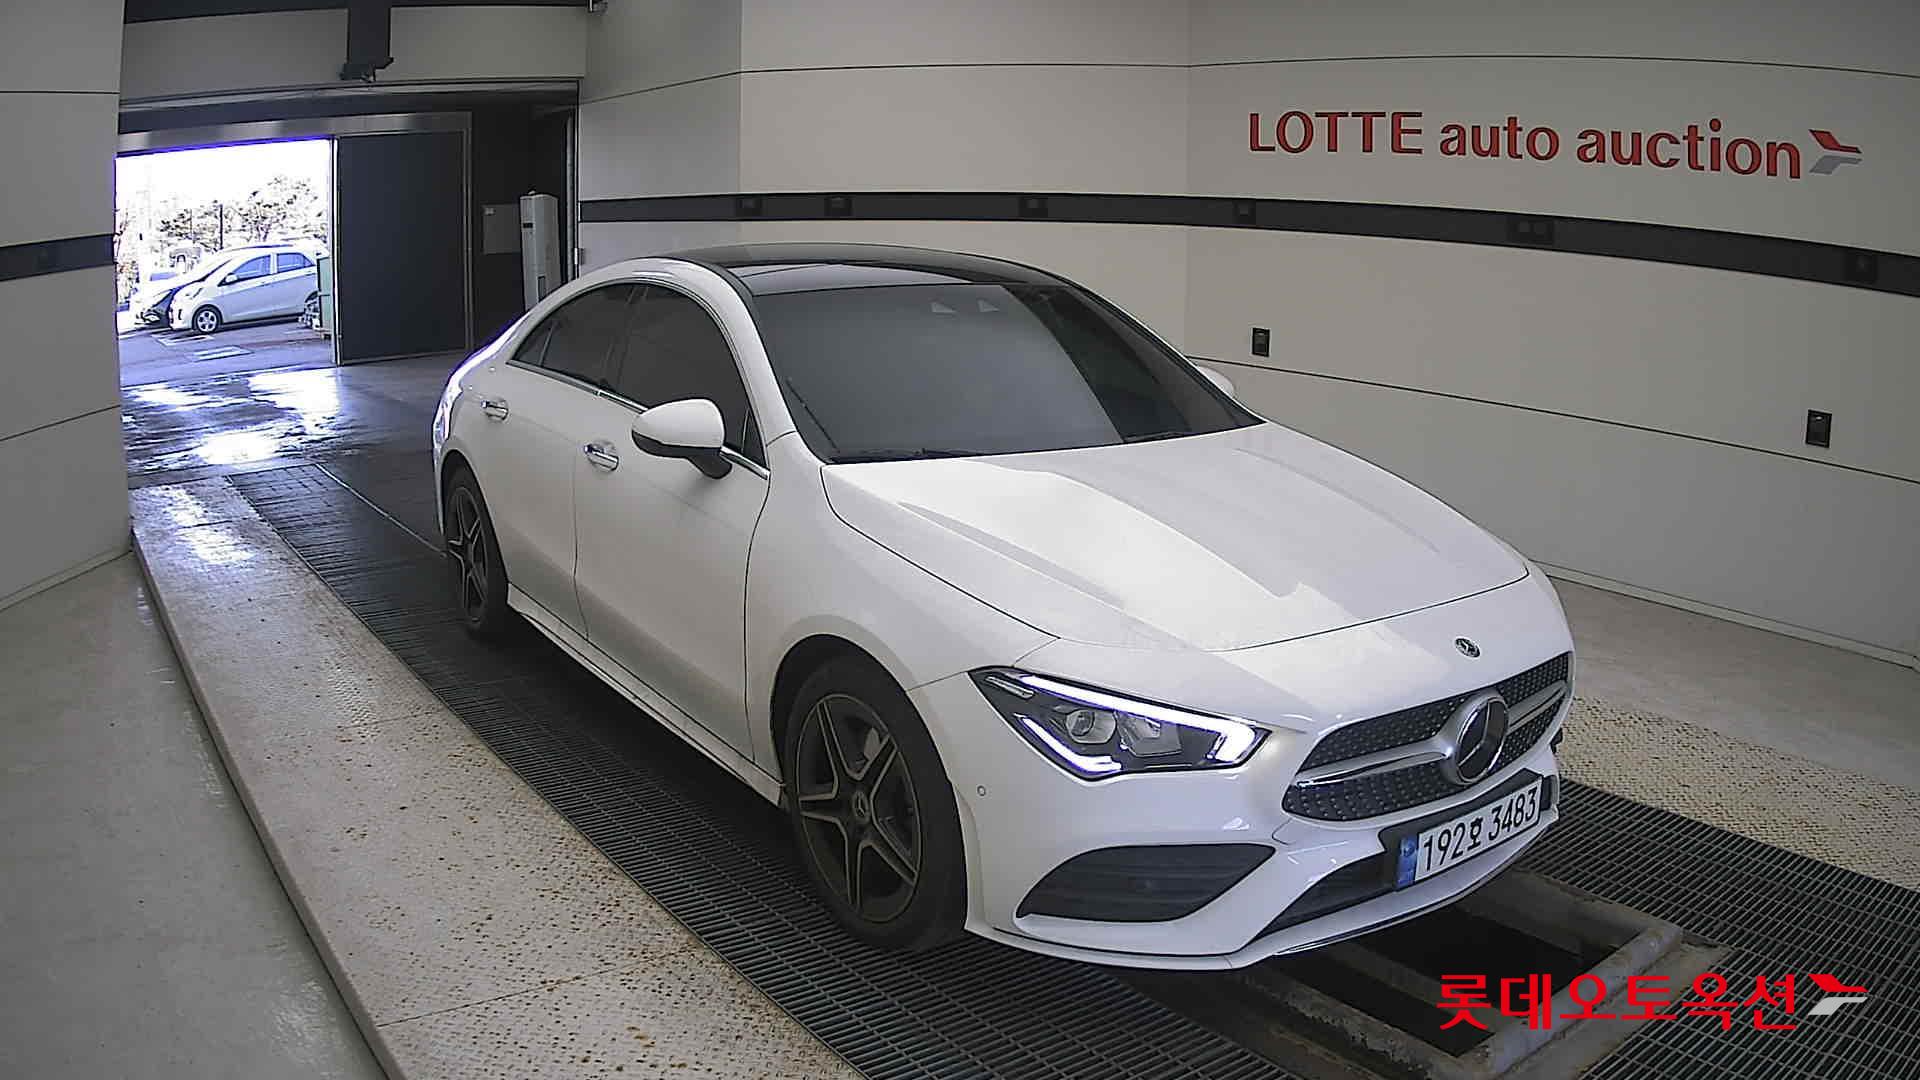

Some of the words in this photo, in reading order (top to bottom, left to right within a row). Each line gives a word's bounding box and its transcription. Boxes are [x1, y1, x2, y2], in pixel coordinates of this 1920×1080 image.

[1248, 111, 1424, 155] LOTTE
[1440, 116, 1560, 161] auto
[1576, 118, 1801, 179] auction
[1488, 786, 1538, 841] 3483
